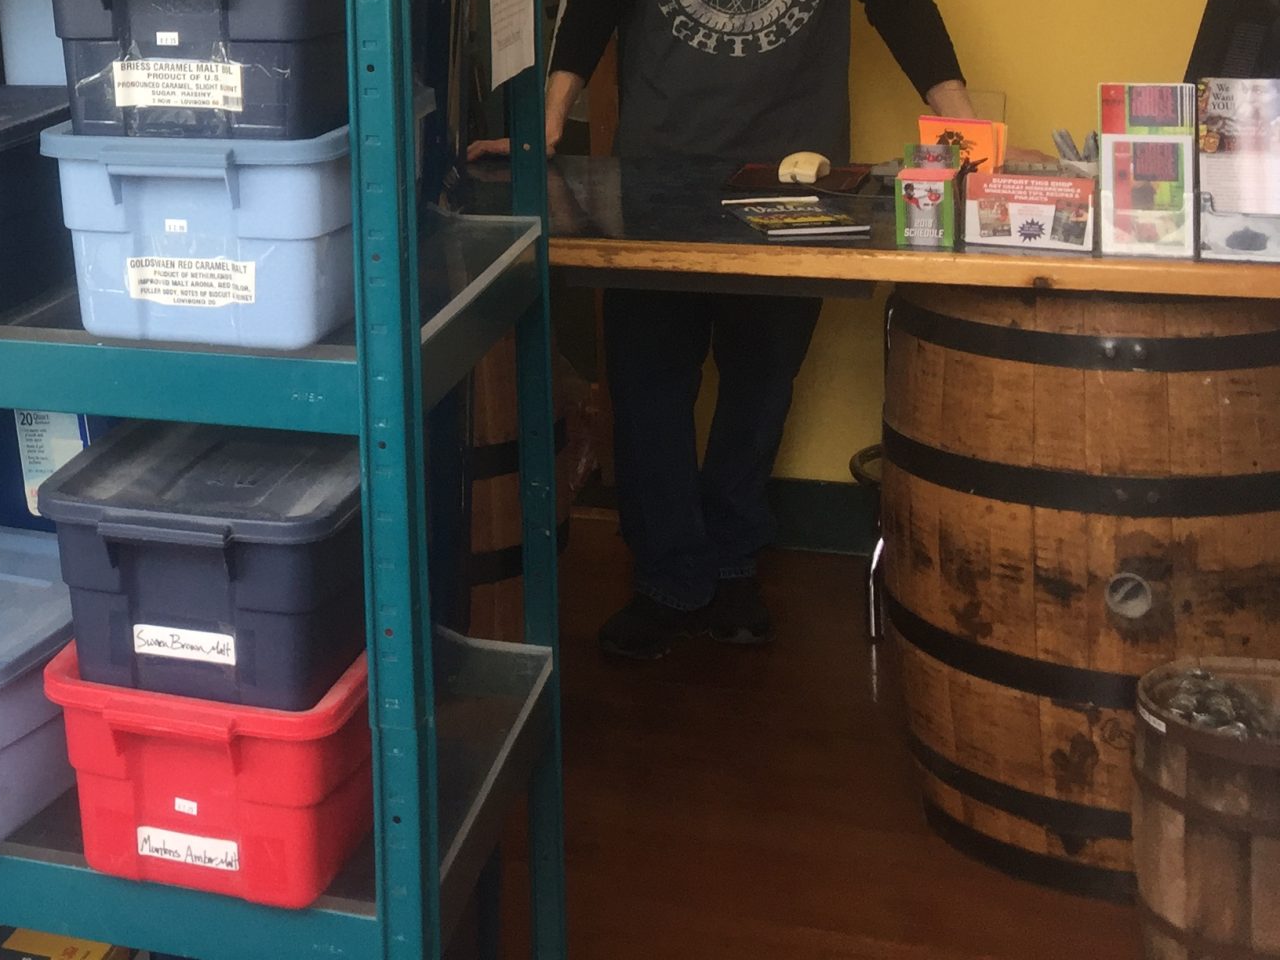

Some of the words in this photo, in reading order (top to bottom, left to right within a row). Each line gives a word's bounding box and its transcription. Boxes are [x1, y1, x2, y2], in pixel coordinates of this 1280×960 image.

[120, 62, 151, 71] BRIESS
[153, 63, 194, 73] CARAMEL
[196, 64, 219, 73] MALT
[1216, 83, 1230, 92] We
[1212, 92, 1234, 101] Want
[1051, 180, 1073, 188] SHOP
[904, 228, 944, 238] SCHEDULE
[130, 258, 175, 269] GOLDSWAEN
[178, 260, 193, 269] RED
[195, 261, 230, 272] CARAMEL
[153, 270, 179, 278] PRODUCT
[190, 272, 233, 280] NETHERLANDS
[20, 412, 33, 426] 20
[169, 633, 206, 654] Brown
[207, 640, 231, 657] Malt
[184, 845, 218, 864] Amber
[217, 851, 240, 869] Malt
